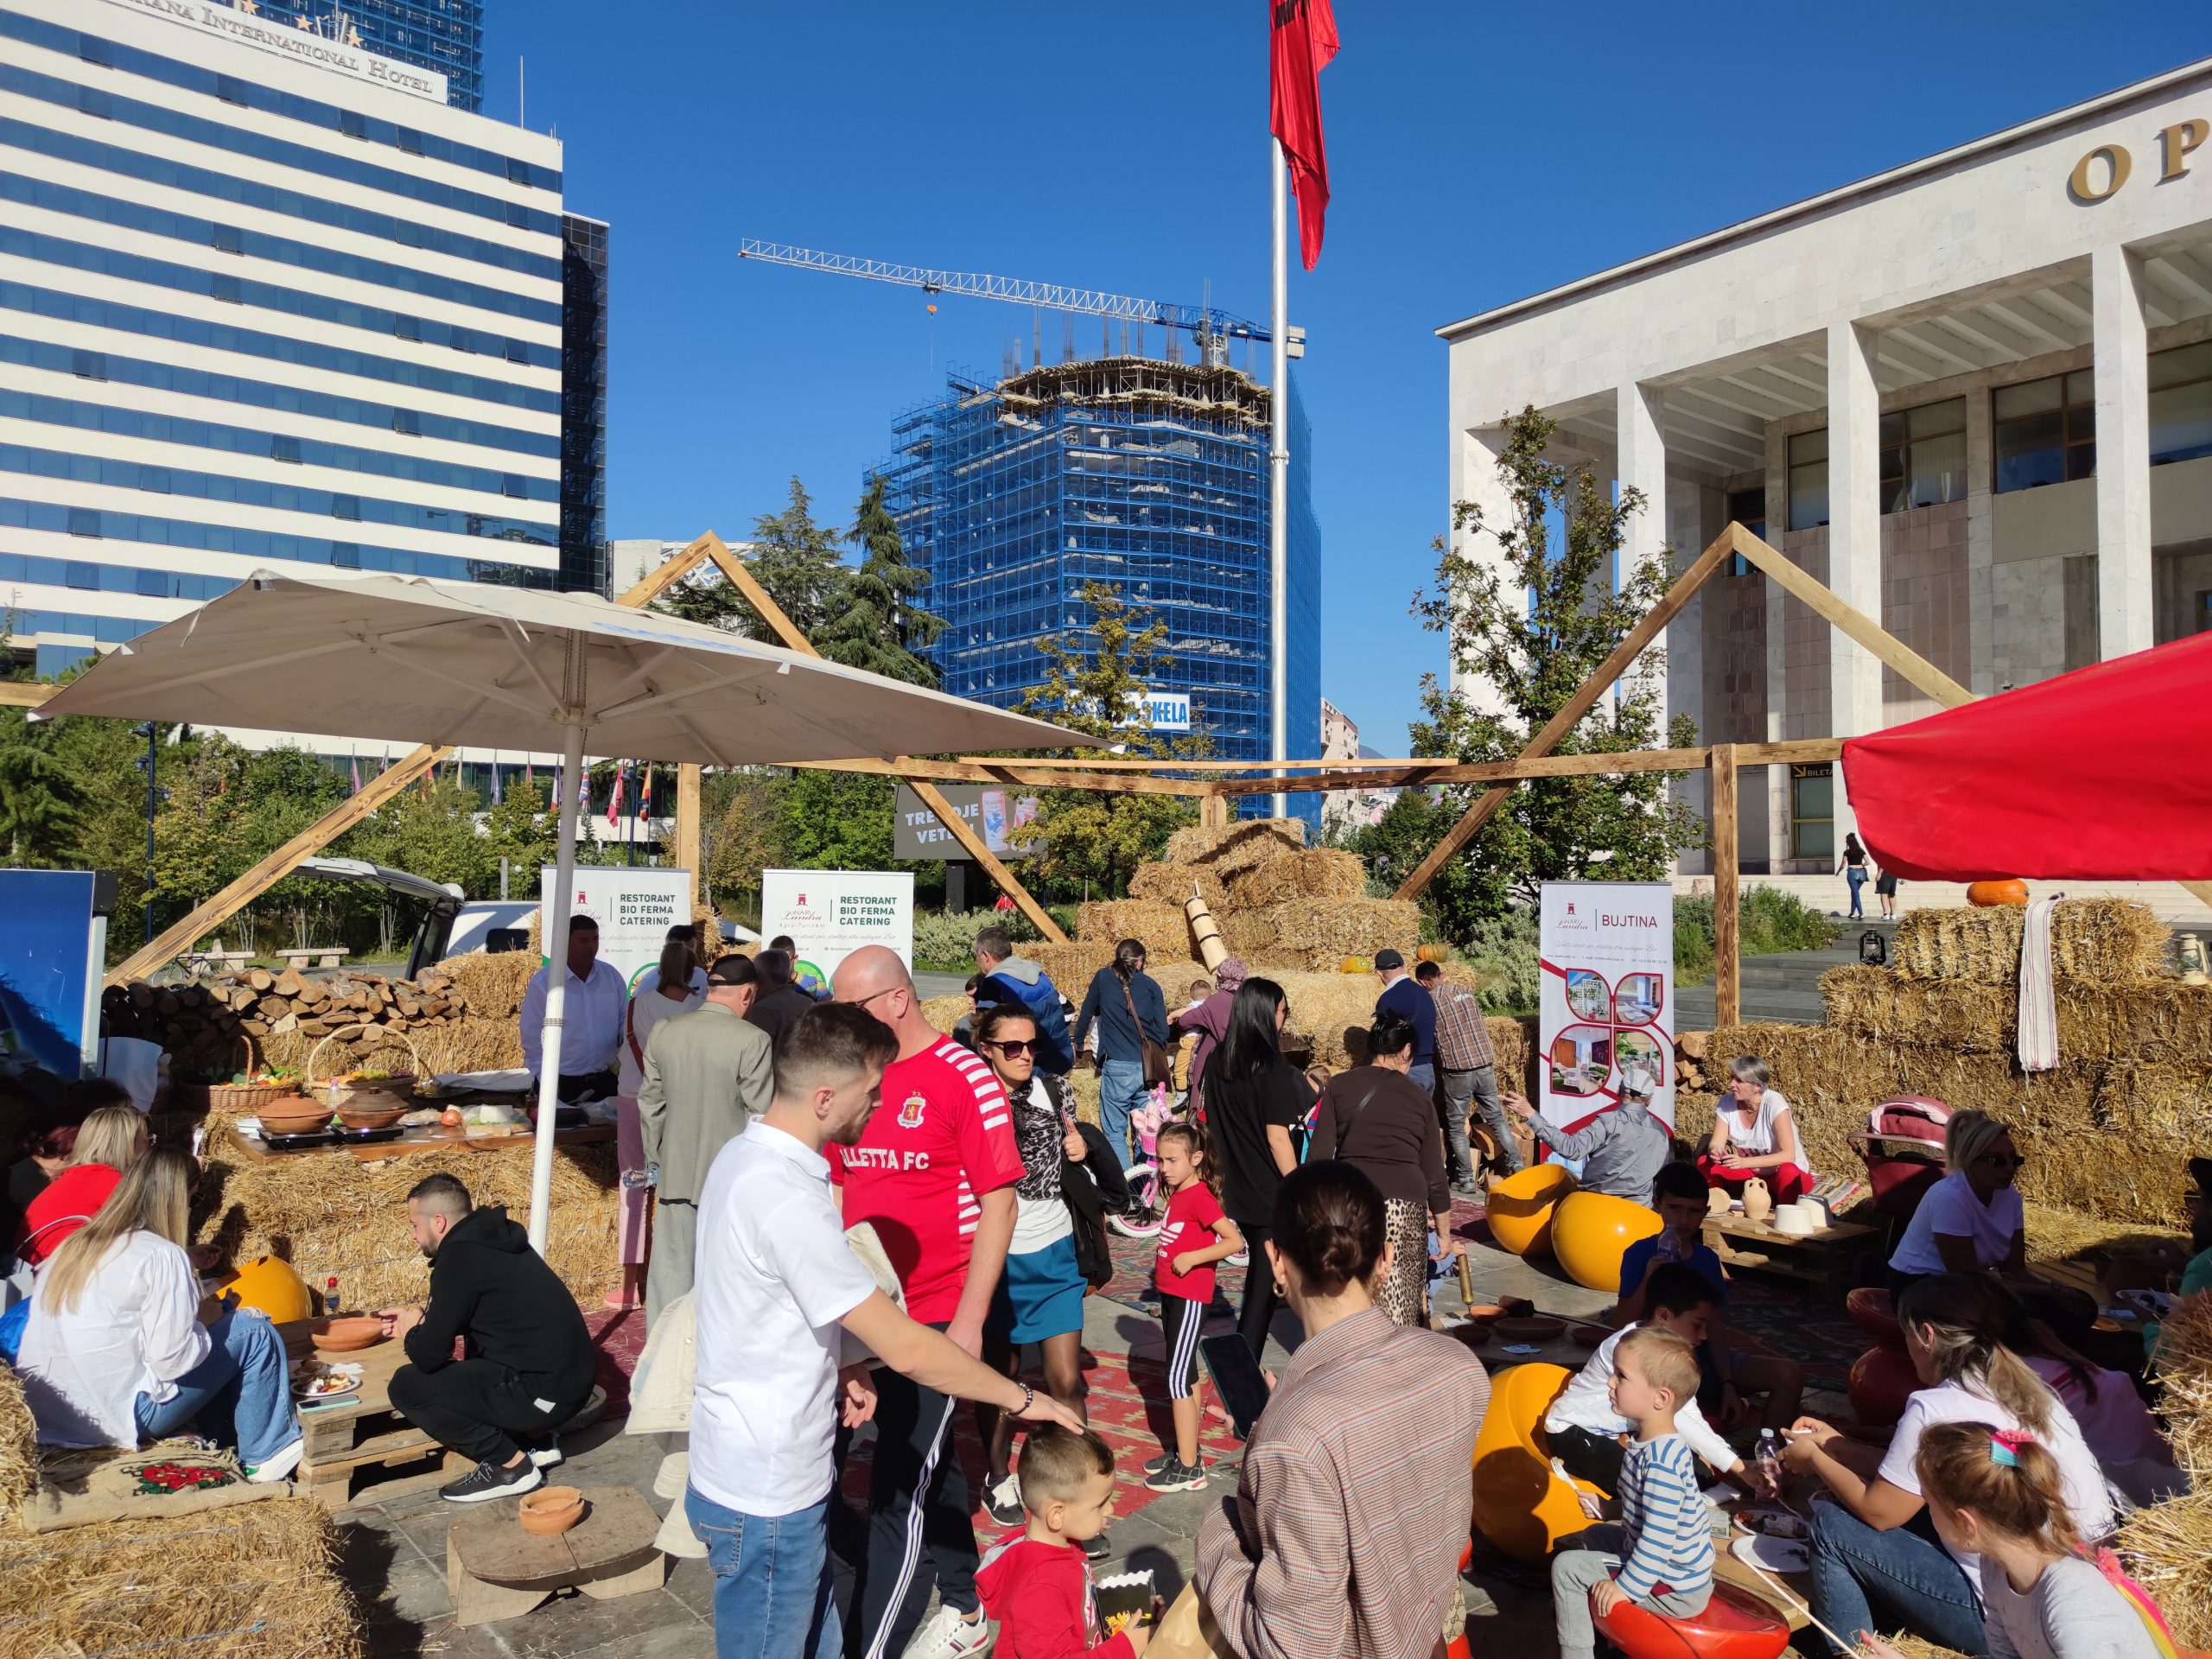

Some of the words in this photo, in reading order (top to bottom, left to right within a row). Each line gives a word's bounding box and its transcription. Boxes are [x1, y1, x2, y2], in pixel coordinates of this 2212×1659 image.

[201, 6, 359, 71] INTERNATIONAL
[368, 58, 433, 93] HOTEL
[905, 803, 979, 827] TREOJE
[916, 823, 975, 844] VET
[620, 893, 676, 903] RESTORANT
[840, 896, 898, 905] RESTORANT
[620, 906, 637, 914] BIO
[640, 906, 674, 914] FERMA
[840, 906, 857, 915] BIO
[861, 907, 895, 916] FERMA
[620, 917, 670, 925] CATERING
[780, 911, 823, 921] Lundra
[839, 917, 891, 925] CATERING
[1602, 914, 1658, 928] BUJTINA
[1554, 919, 1589, 930] Lundra
[903, 1151, 930, 1171] FC
